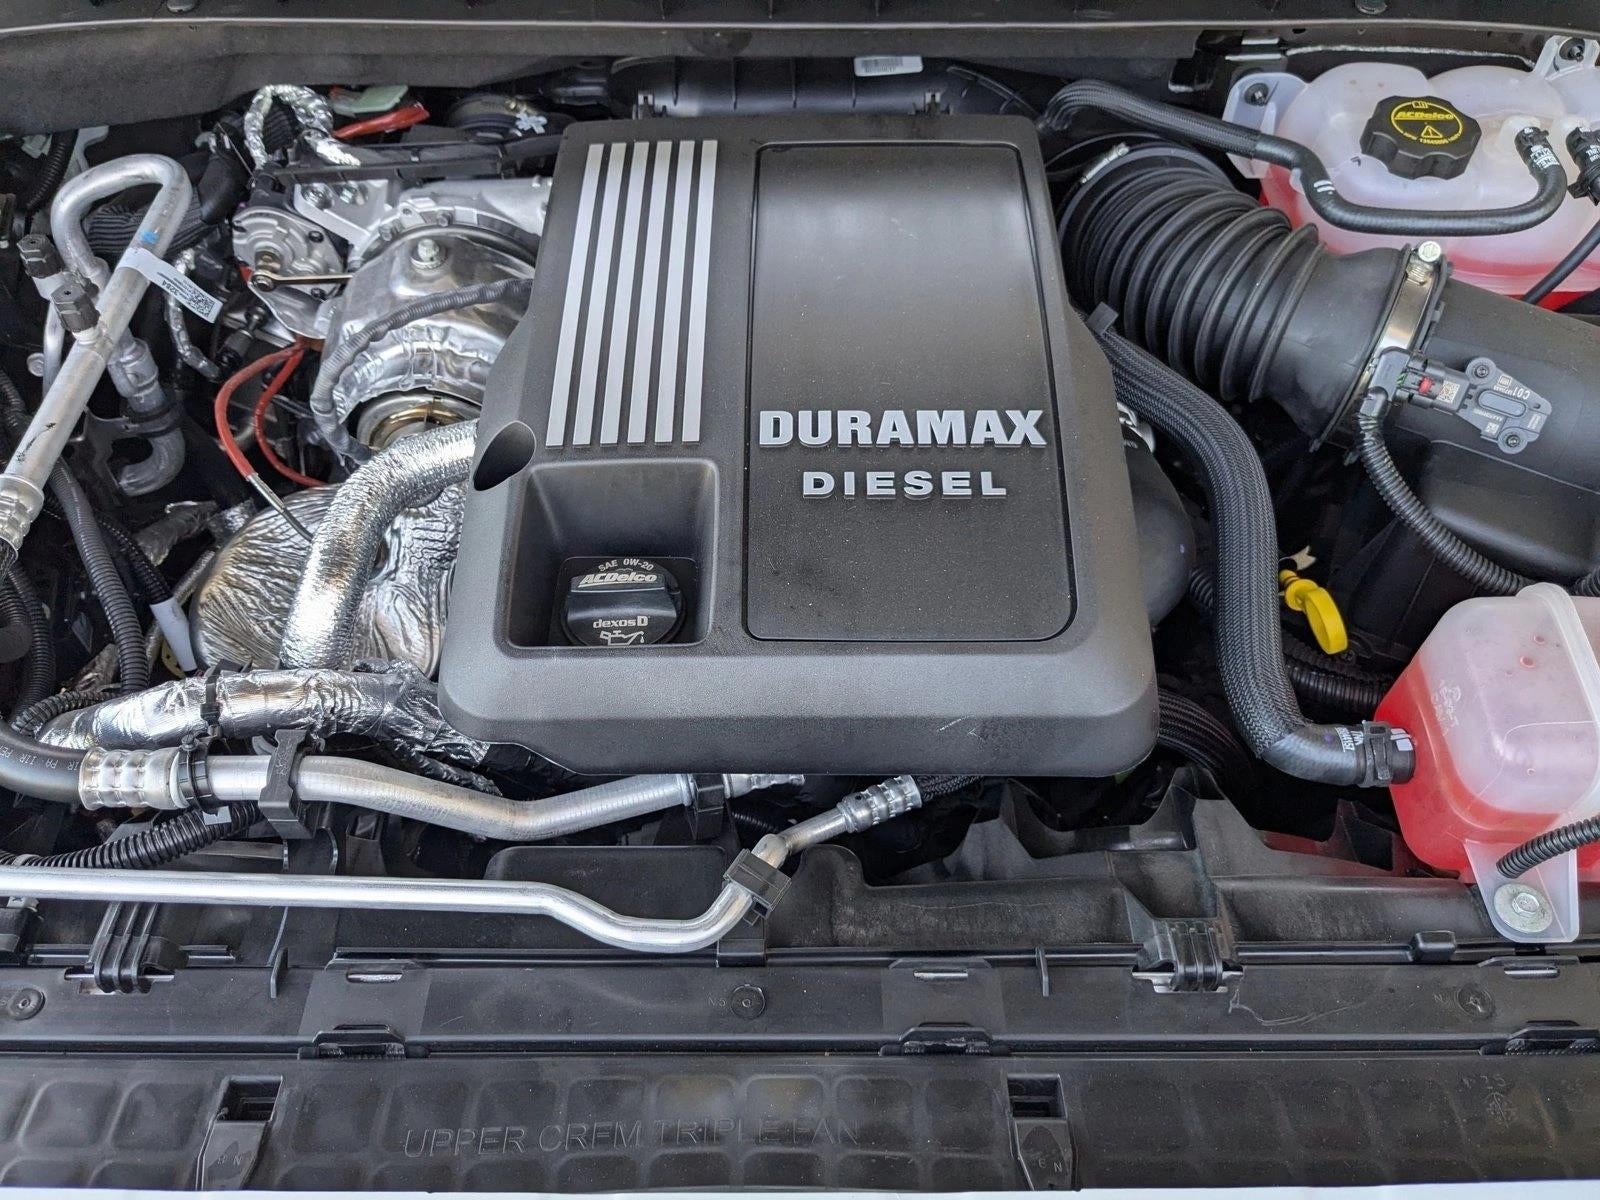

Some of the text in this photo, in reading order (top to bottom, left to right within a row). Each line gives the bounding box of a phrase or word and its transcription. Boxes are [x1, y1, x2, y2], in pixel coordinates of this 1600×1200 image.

[759, 410, 1047, 447] DURAMAX
[803, 471, 1006, 498] DIESEL
[598, 558, 654, 572] SAE 0W-20
[577, 571, 658, 588] ACDelco
[404, 1126, 526, 1157] UPPER
[653, 1118, 783, 1146] TRIPLE
[792, 1118, 861, 1146] FAN
